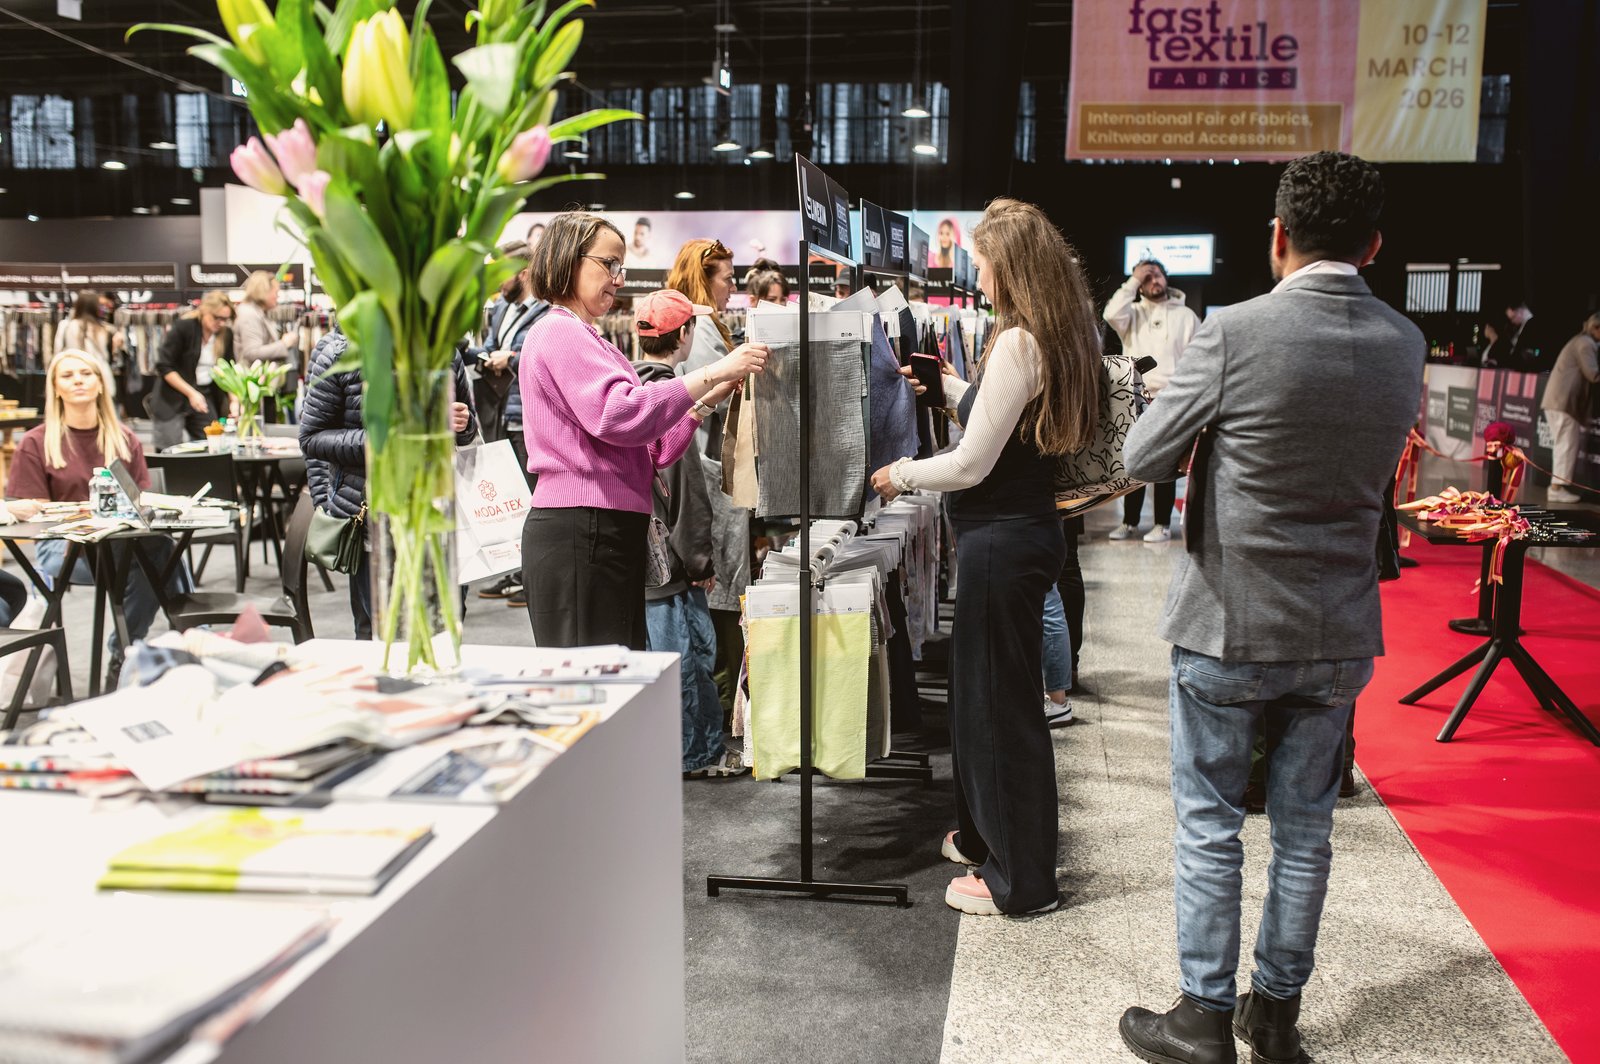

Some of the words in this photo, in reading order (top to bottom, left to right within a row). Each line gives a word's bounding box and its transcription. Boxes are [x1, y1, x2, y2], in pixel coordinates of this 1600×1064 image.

[1129, 0, 1221, 34] fast
[1146, 22, 1298, 61] textile
[1368, 57, 1467, 77] MARCH
[1154, 72, 1292, 85] FABRICS
[1401, 88, 1464, 109] 2026
[1088, 110, 1193, 125] International
[1196, 110, 1226, 126] Fair
[1230, 110, 1247, 126] of
[1249, 110, 1313, 127] Fabrics,
[1087, 130, 1159, 145] Knitwear
[1162, 131, 1195, 145] and
[1198, 130, 1296, 145] Accessories
[474, 504, 503, 518] MODA
[503, 498, 523, 512] TEX
